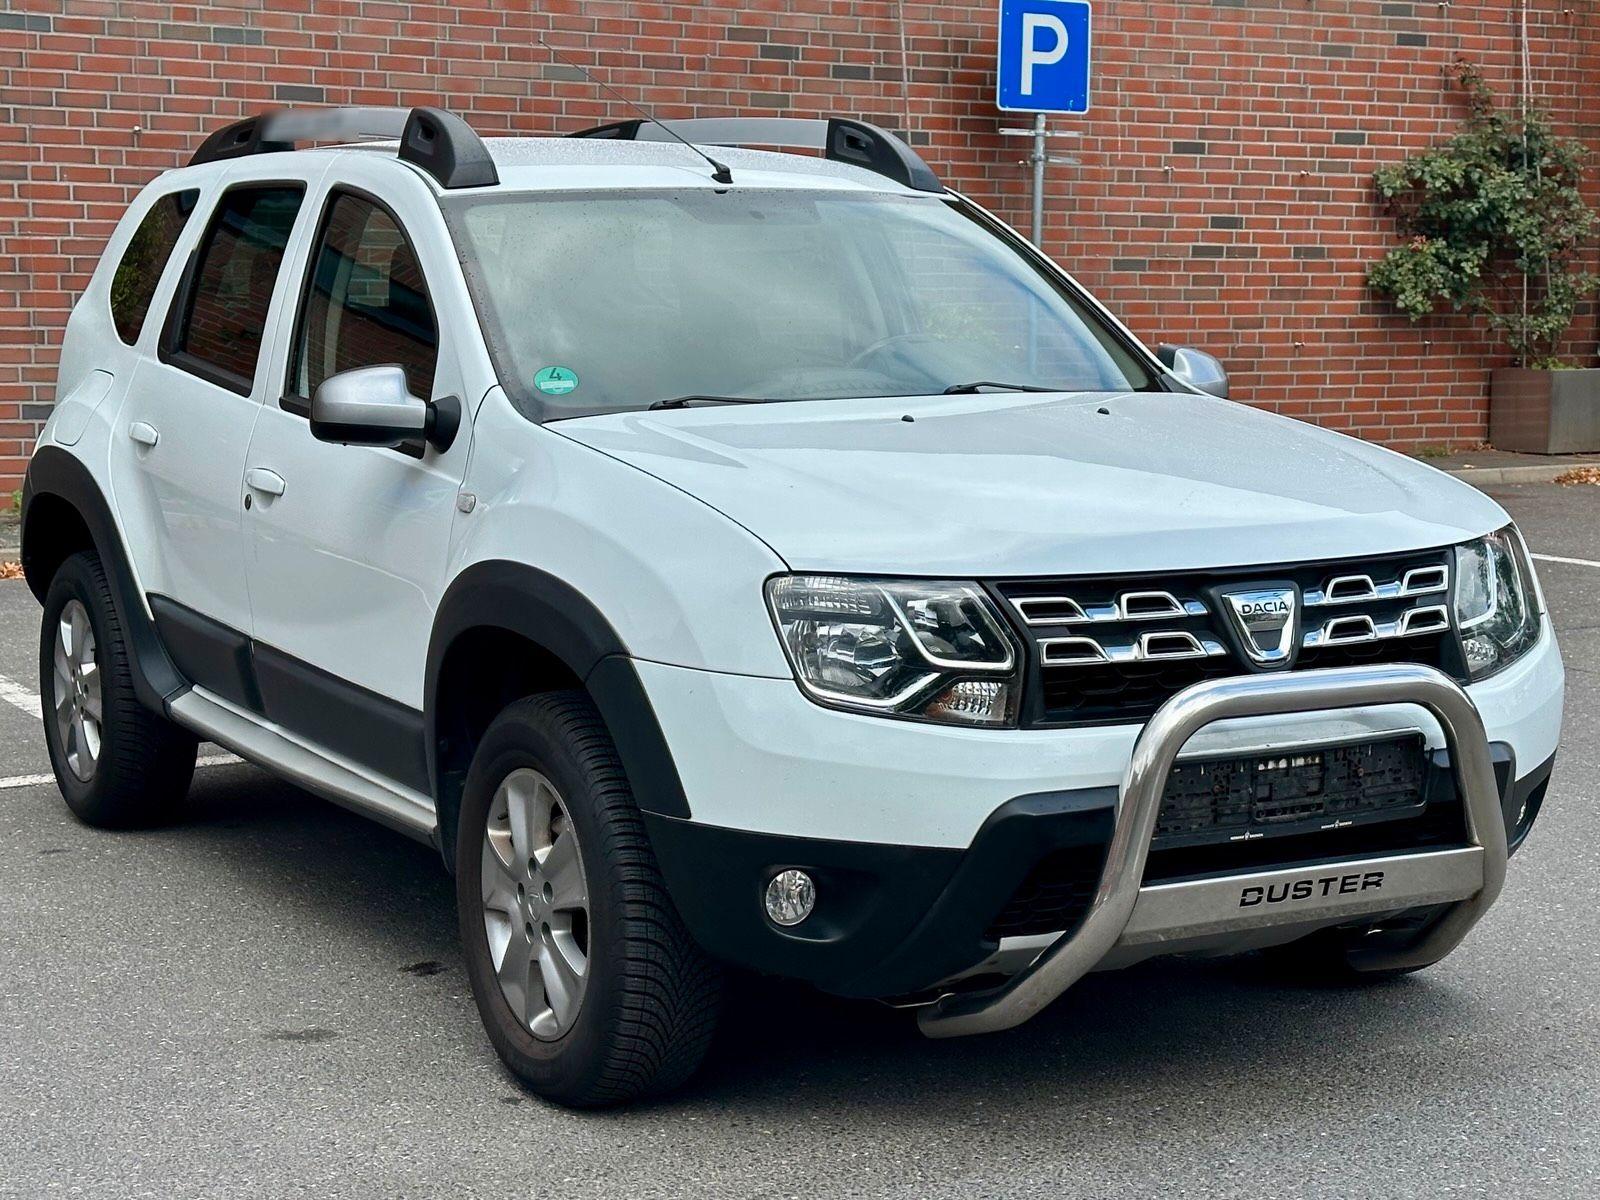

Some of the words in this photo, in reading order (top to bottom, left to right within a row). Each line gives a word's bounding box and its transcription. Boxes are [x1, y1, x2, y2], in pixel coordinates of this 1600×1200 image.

[1020, 12, 1069, 96] P
[549, 367, 562, 381] 4
[1241, 601, 1289, 614] DACIA
[1239, 871, 1385, 907] DUSTER
